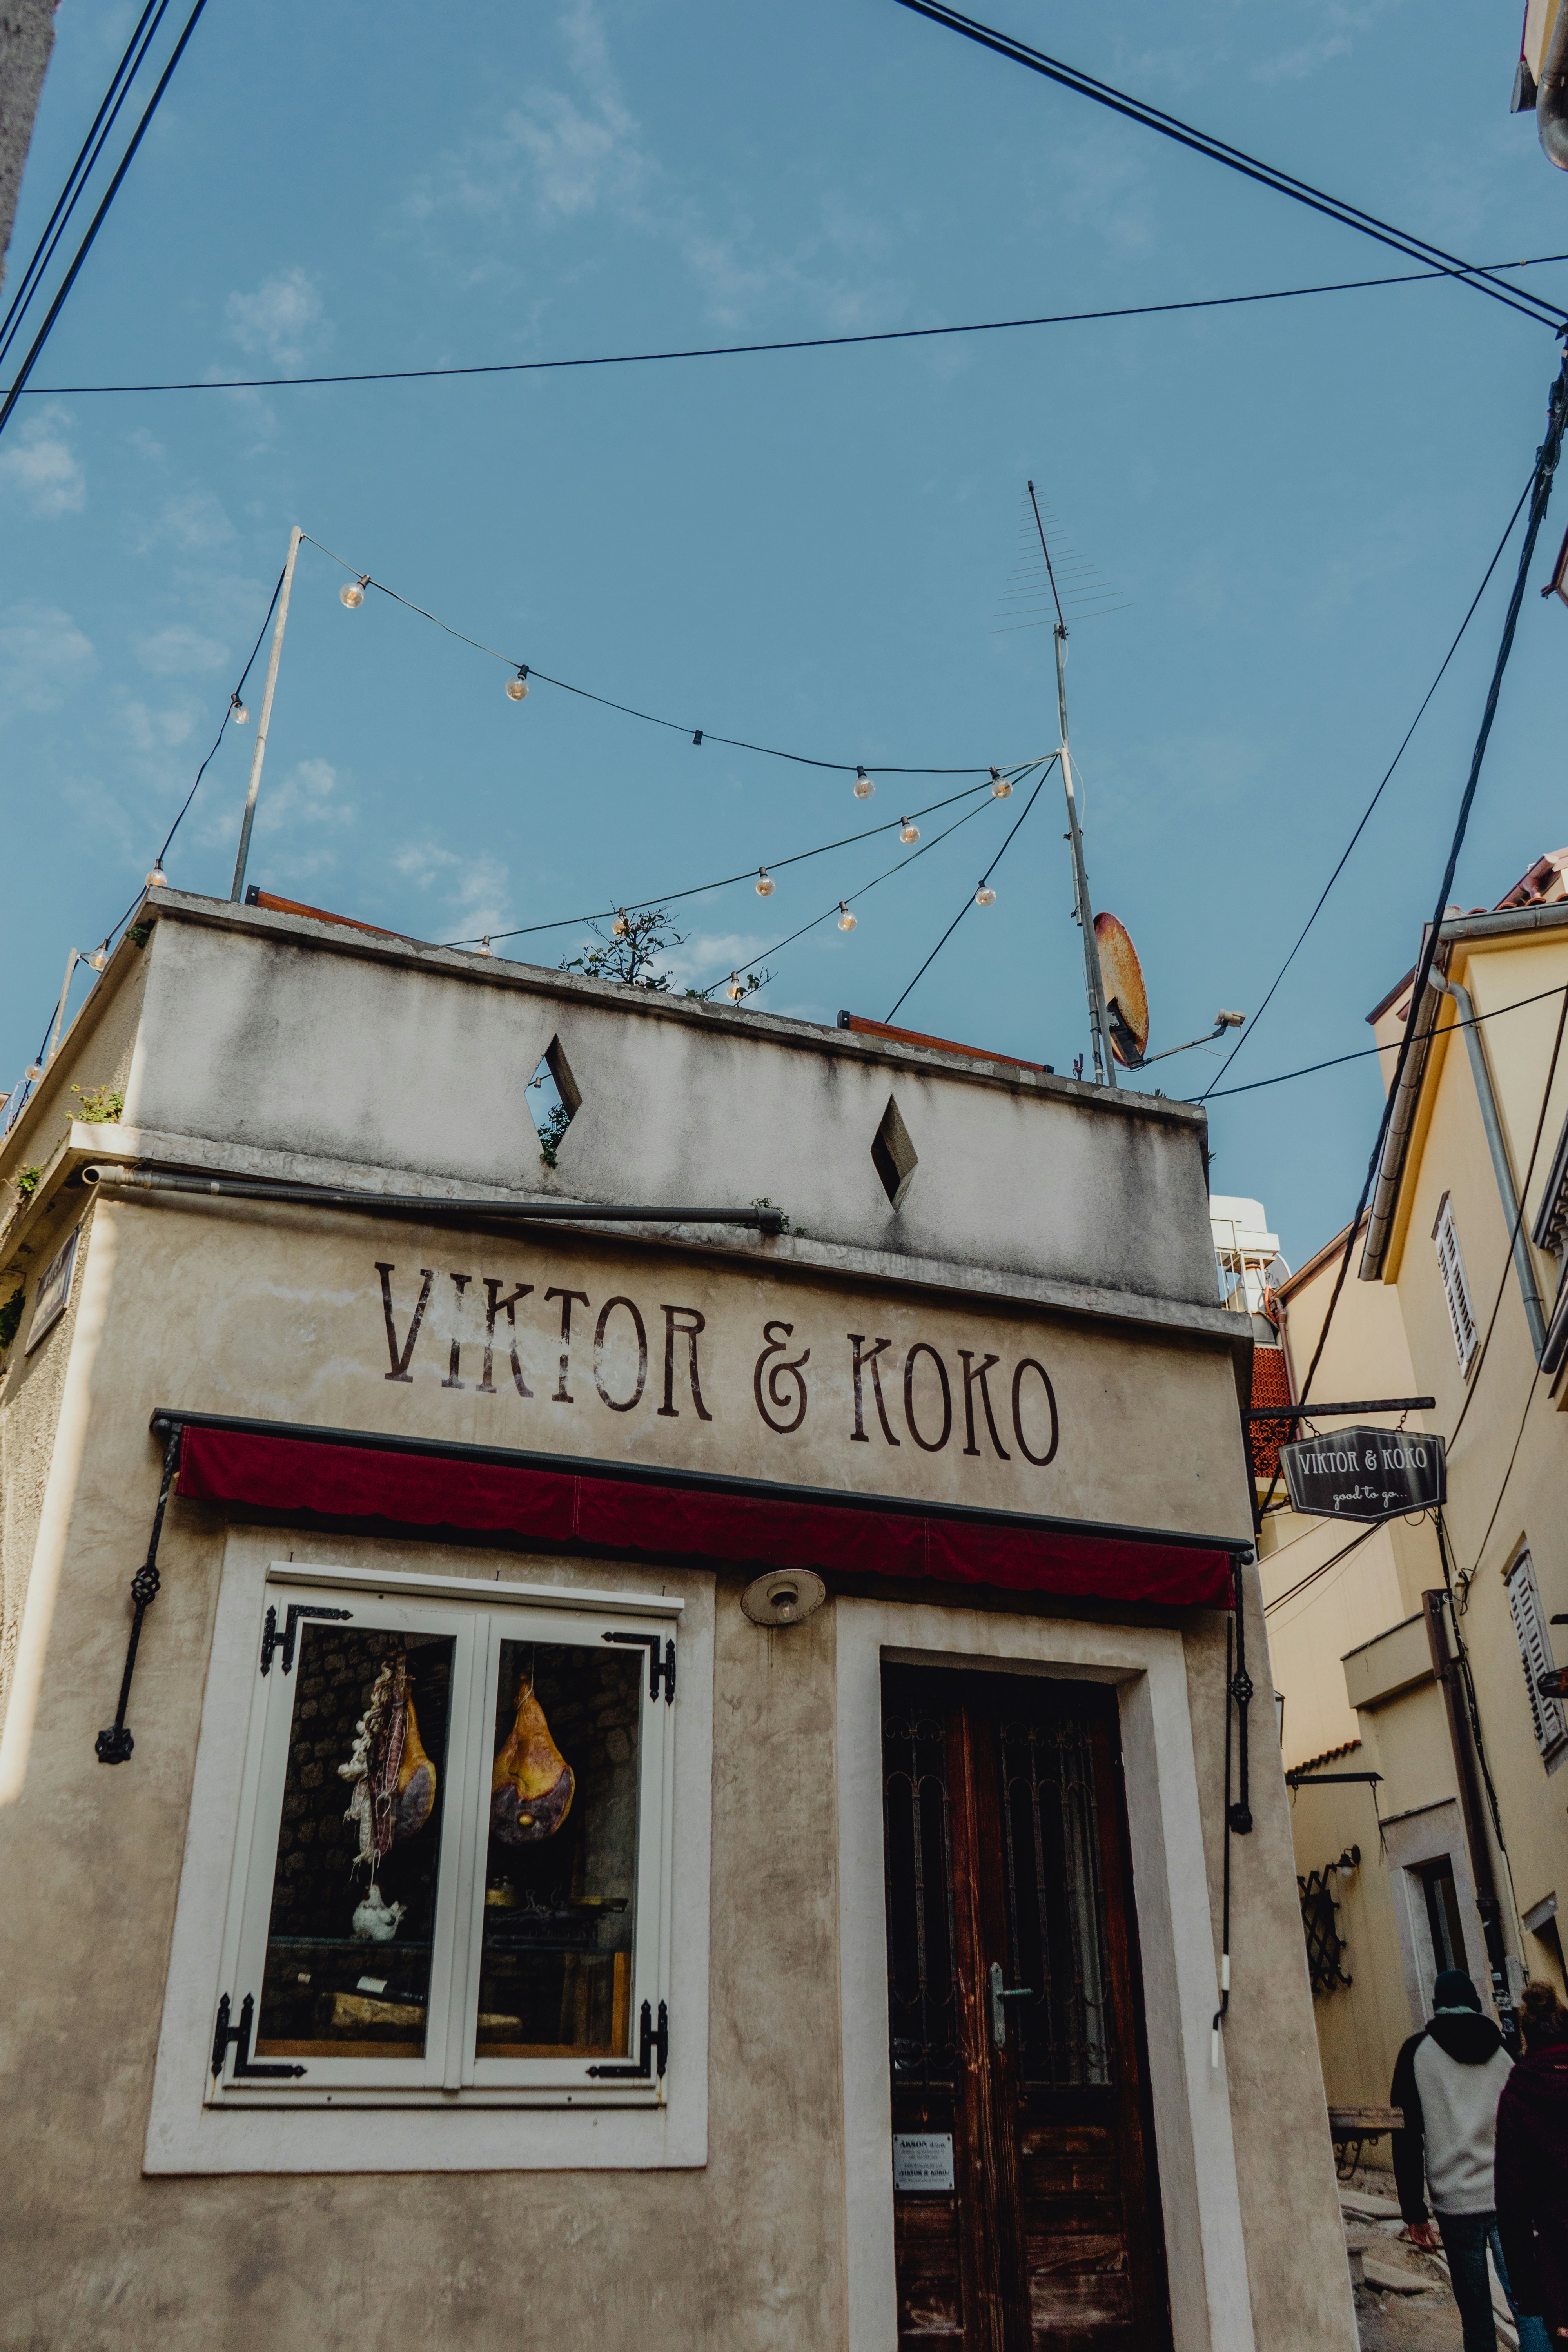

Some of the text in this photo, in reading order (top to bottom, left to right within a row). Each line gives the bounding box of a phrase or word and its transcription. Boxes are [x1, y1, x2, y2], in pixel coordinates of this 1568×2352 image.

[374, 1261, 1060, 1467] VIKTOR & KOKO
[1298, 1447, 1428, 1474] VIKTOR & KOKO
[1333, 1485, 1407, 1510] good to go...
